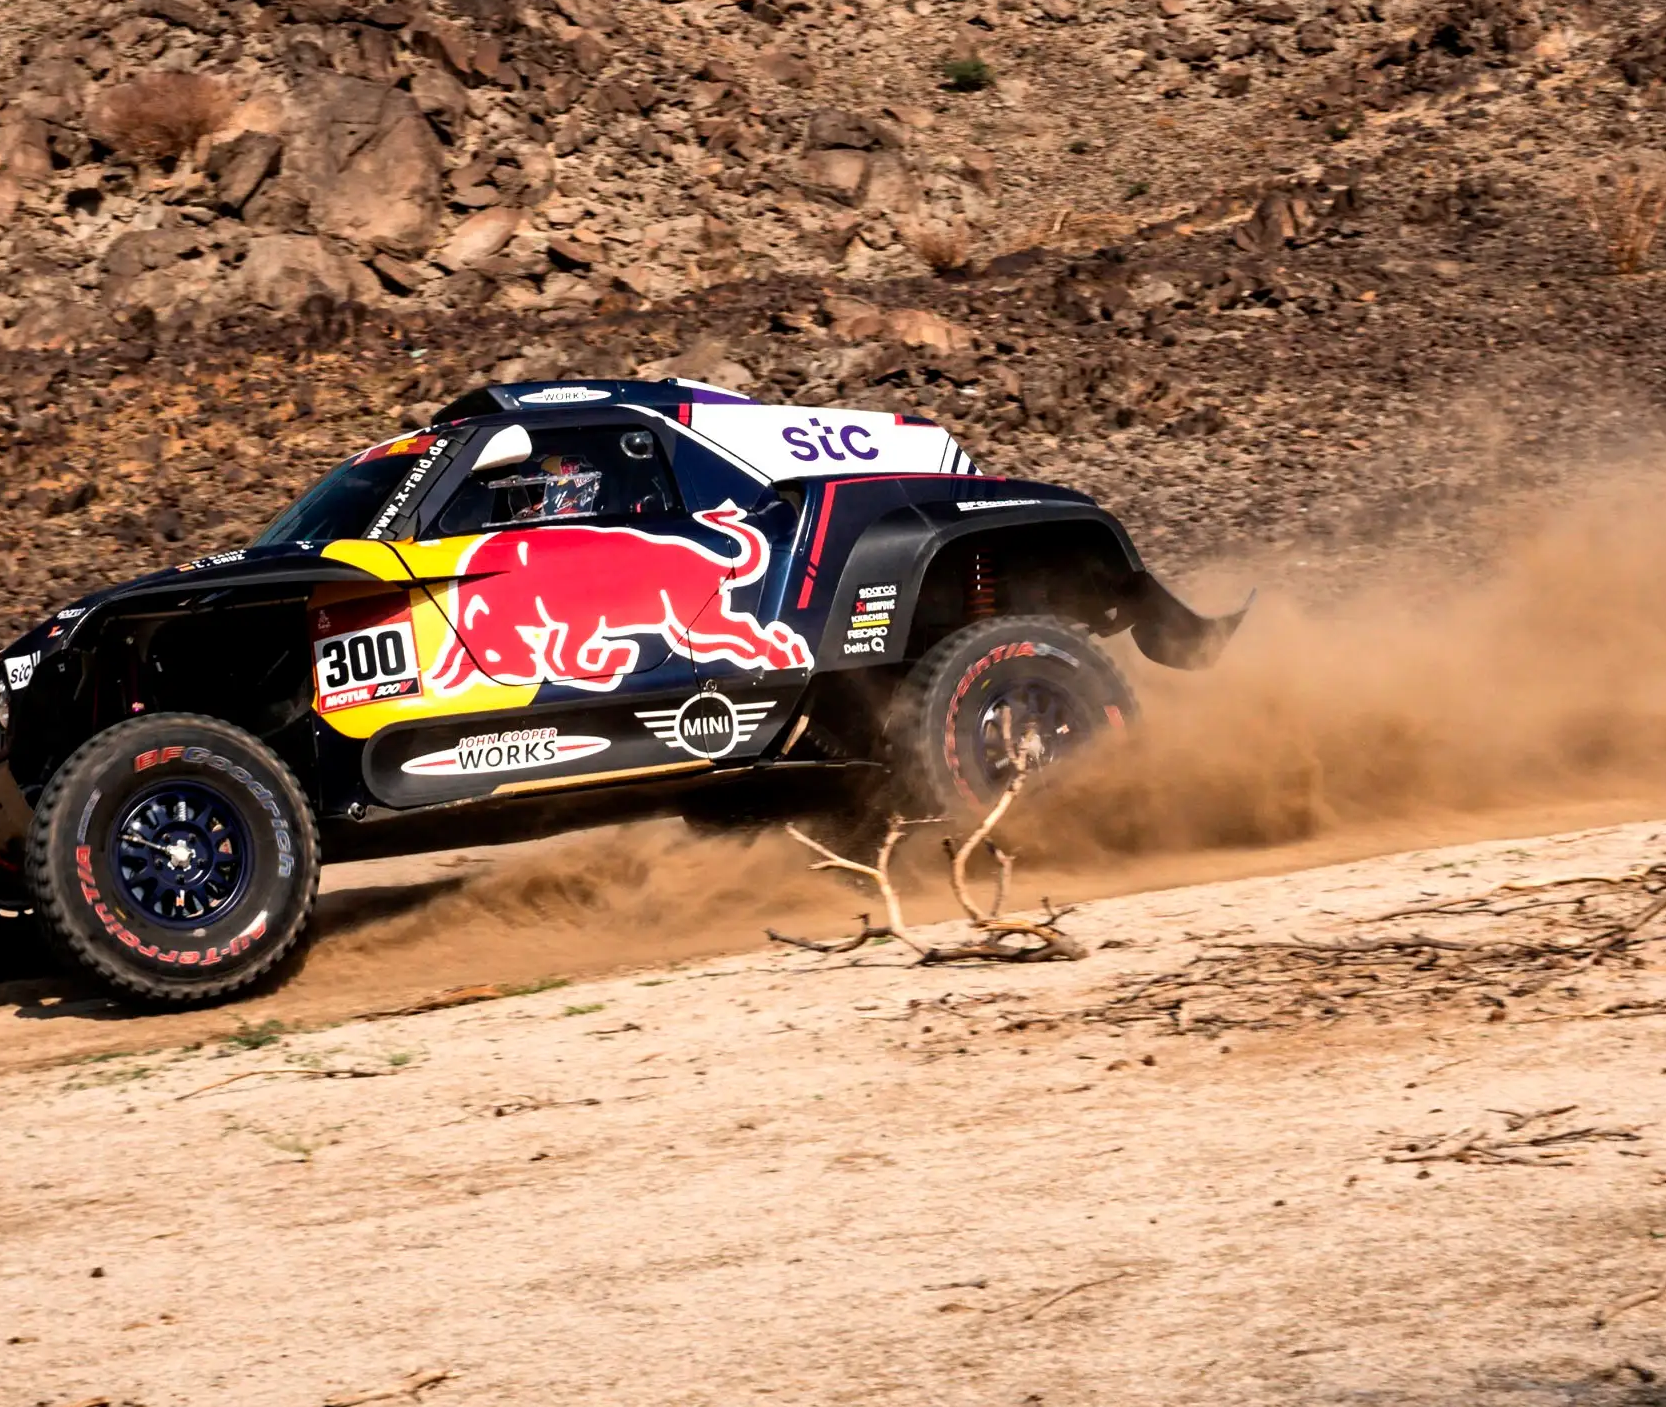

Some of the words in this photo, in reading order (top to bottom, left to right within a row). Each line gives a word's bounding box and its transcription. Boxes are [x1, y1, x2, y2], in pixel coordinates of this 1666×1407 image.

[544, 391, 588, 402] WORKS
[367, 438, 448, 540] www.x-raid.de
[213, 554, 245, 565] CRUZ
[847, 626, 888, 640] RECARO
[844, 642, 870, 654] Delta
[322, 630, 407, 689] 300
[324, 688, 371, 708] MOTUL
[375, 681, 414, 699] 300V
[684, 715, 730, 737] MINI
[459, 735, 497, 749] JOHN
[501, 728, 558, 743] COOPER
[458, 741, 556, 771] WORKS
[135, 746, 295, 879] BFGoodrich
